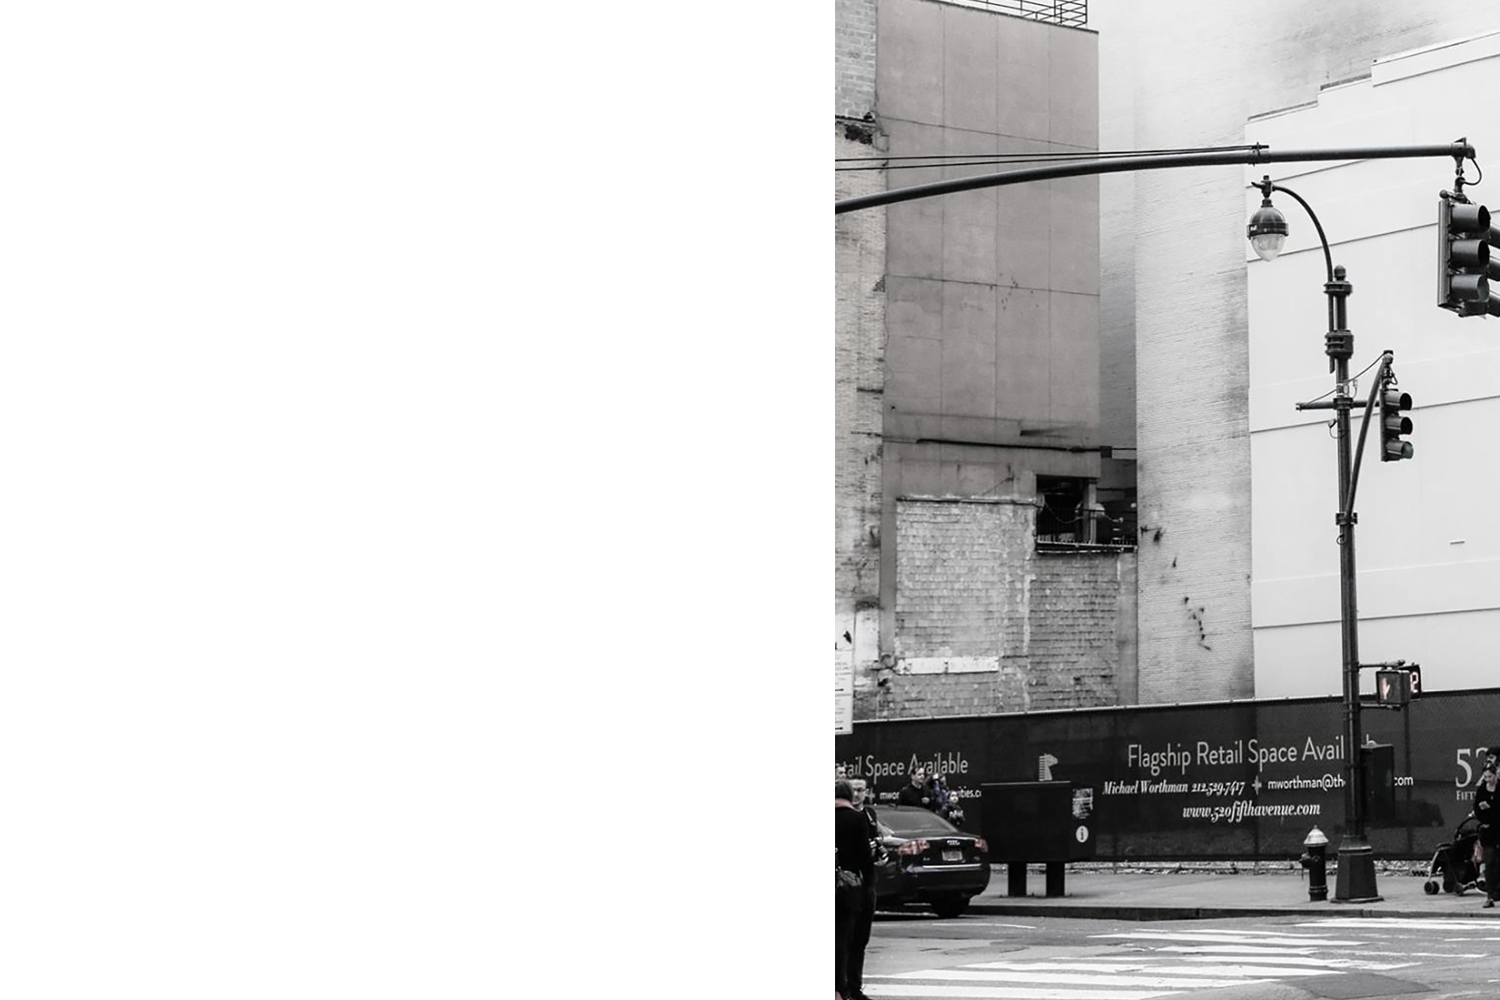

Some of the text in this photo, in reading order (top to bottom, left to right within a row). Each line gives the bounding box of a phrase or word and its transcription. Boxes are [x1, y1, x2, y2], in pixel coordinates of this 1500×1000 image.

[1128, 743, 1191, 776] Flagship
[1197, 739, 1243, 765] Retail
[1248, 738, 1298, 772] Space
[865, 754, 905, 785] Space
[1102, 780, 1138, 795] Michael
[1140, 779, 1188, 794] Worthman
[1191, 780, 1246, 796] 212.529.7417
[1456, 790, 1477, 801] FIFT
[1182, 800, 1321, 823] www.520fifthavenue.com
